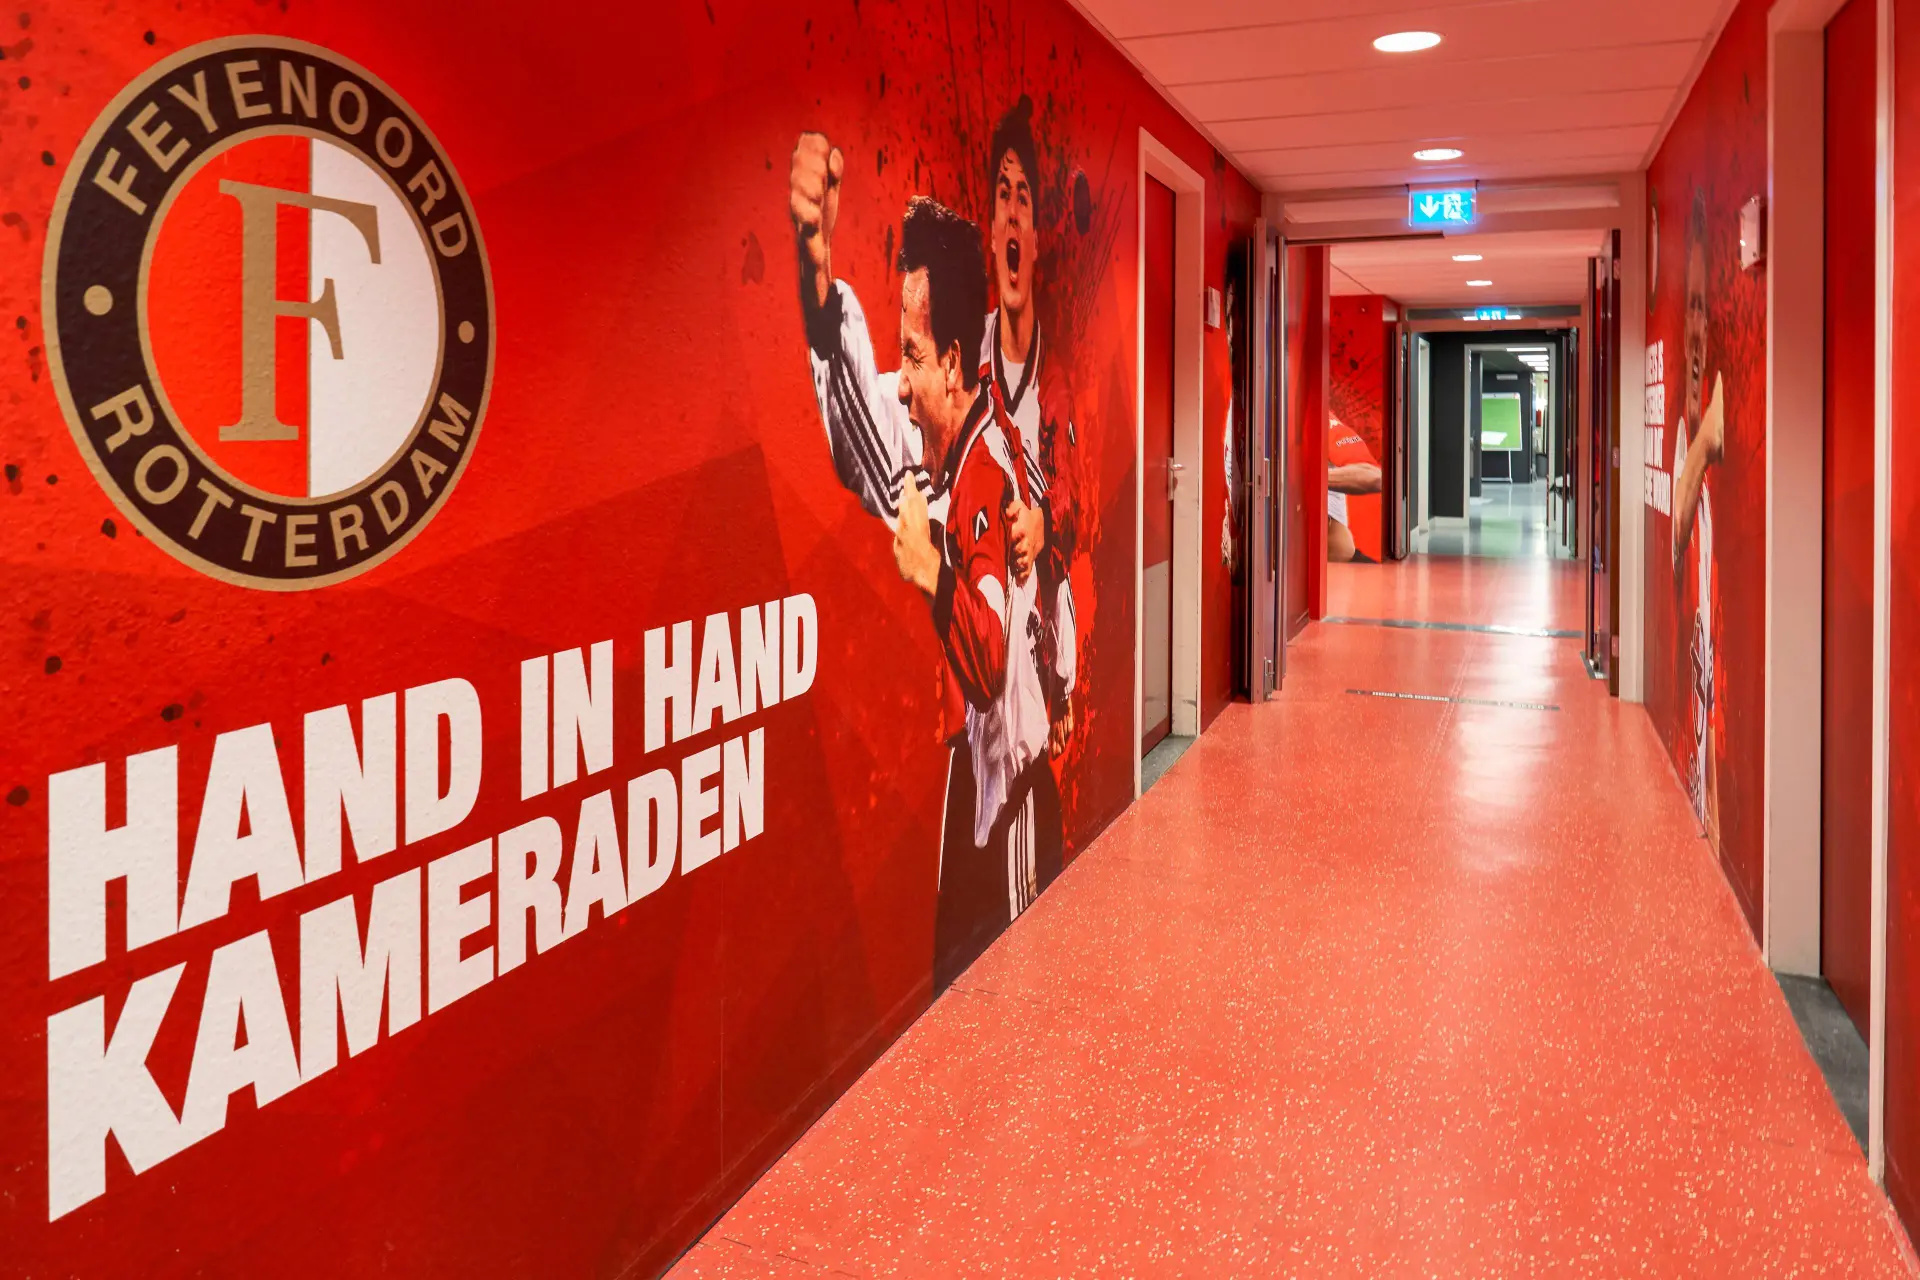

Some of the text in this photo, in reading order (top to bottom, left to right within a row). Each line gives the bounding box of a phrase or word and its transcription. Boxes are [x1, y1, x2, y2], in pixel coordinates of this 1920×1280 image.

[93, 60, 469, 258] FEYENOORD
[218, 178, 382, 441] F
[90, 384, 472, 567] ROTTERDAM
[48, 592, 819, 982] HAND IN HAND
[47, 727, 766, 1224] KAMERADEN
